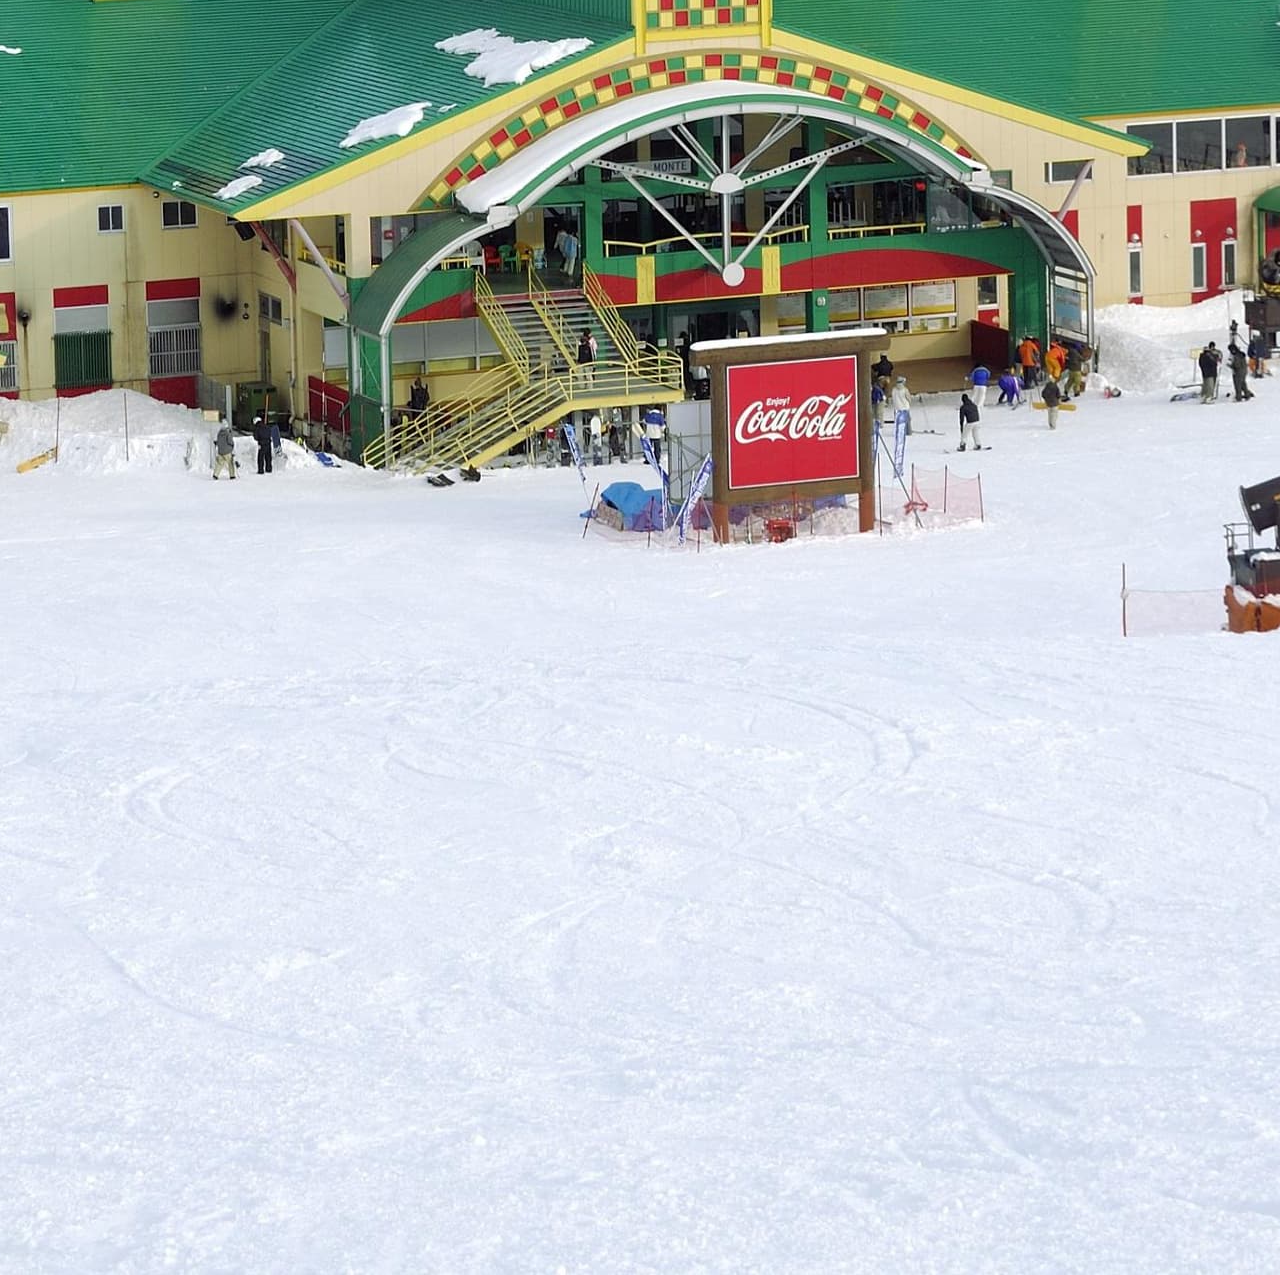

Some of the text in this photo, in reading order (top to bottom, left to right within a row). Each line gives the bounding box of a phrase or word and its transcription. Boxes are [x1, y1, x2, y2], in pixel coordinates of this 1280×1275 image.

[653, 159, 688, 172] MONTE
[766, 396, 791, 407] Enjoy!
[734, 392, 853, 444] Coca-Cola
